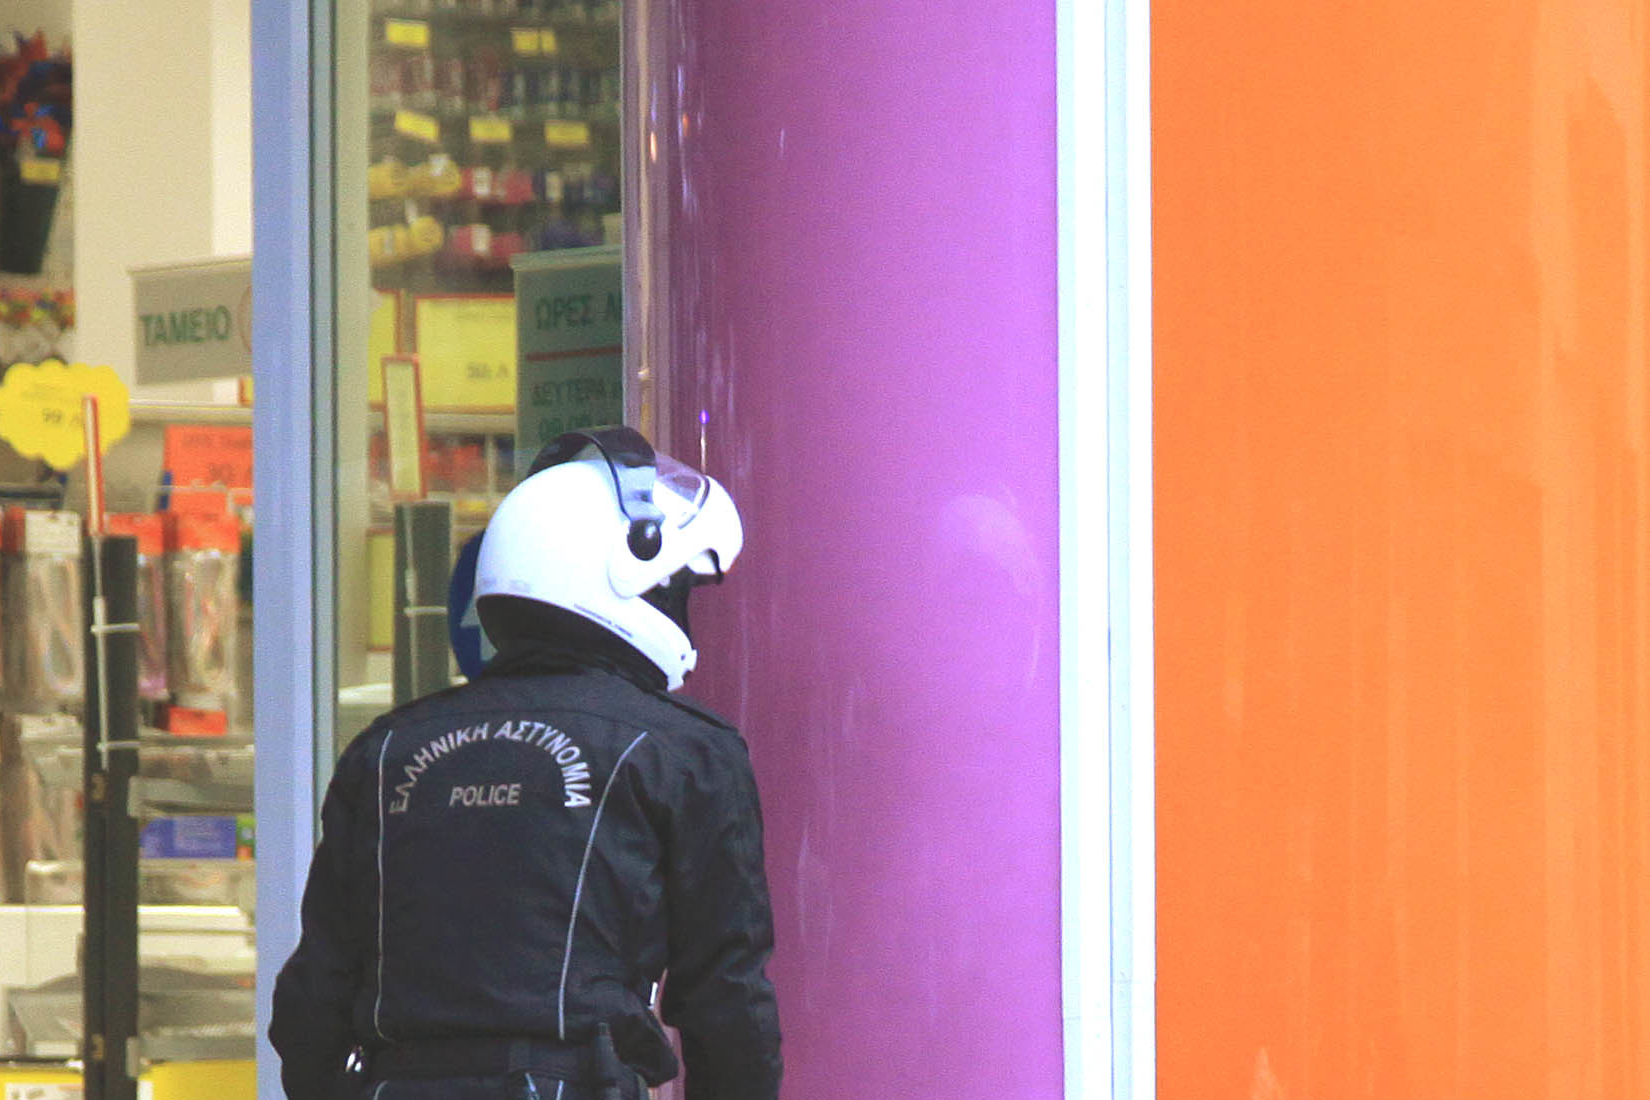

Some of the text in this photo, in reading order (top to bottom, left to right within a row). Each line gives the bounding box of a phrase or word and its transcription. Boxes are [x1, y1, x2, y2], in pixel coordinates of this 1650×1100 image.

[139, 305, 232, 346] ΤΑΜΕΙΟ
[389, 720, 592, 814] ΕΛΛΗΝΙΚΗ ΑΣΤΥΝΟΜΙΑ
[449, 783, 521, 807] POLICE
